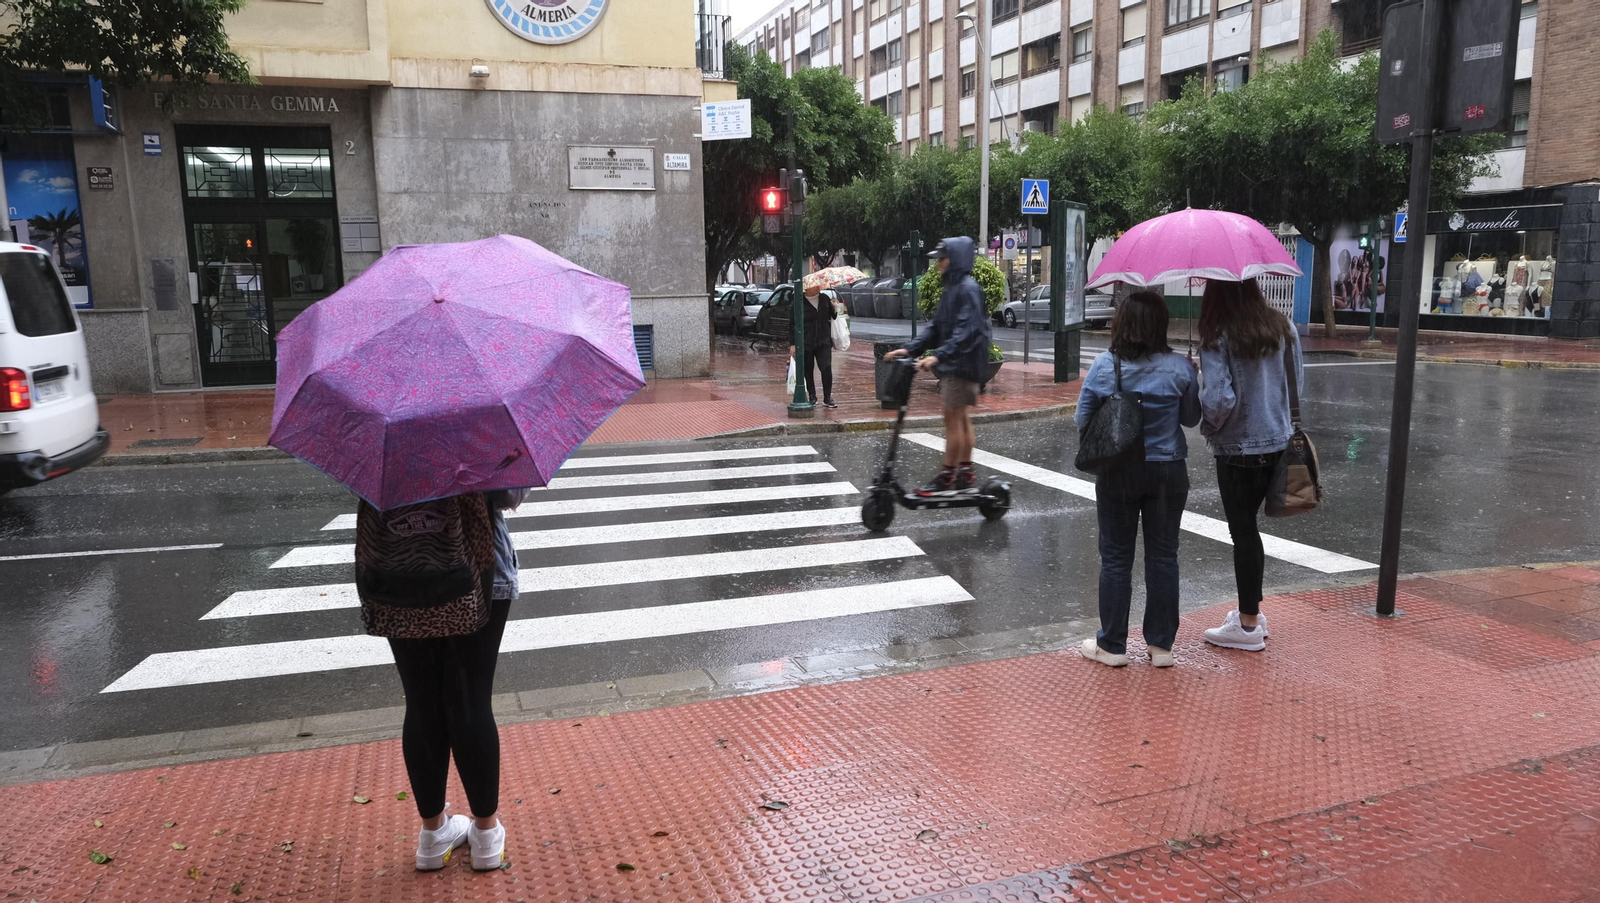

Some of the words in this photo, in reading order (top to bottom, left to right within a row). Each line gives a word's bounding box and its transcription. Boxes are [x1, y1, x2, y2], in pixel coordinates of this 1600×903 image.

[520, 4, 577, 22] ALMERIA
[198, 93, 262, 110] SANTA
[270, 95, 340, 113] GEMMA
[345, 140, 355, 155] 2
[1466, 209, 1520, 230] camelia
[405, 514, 427, 523] VANS
[409, 520, 424, 530] THE
